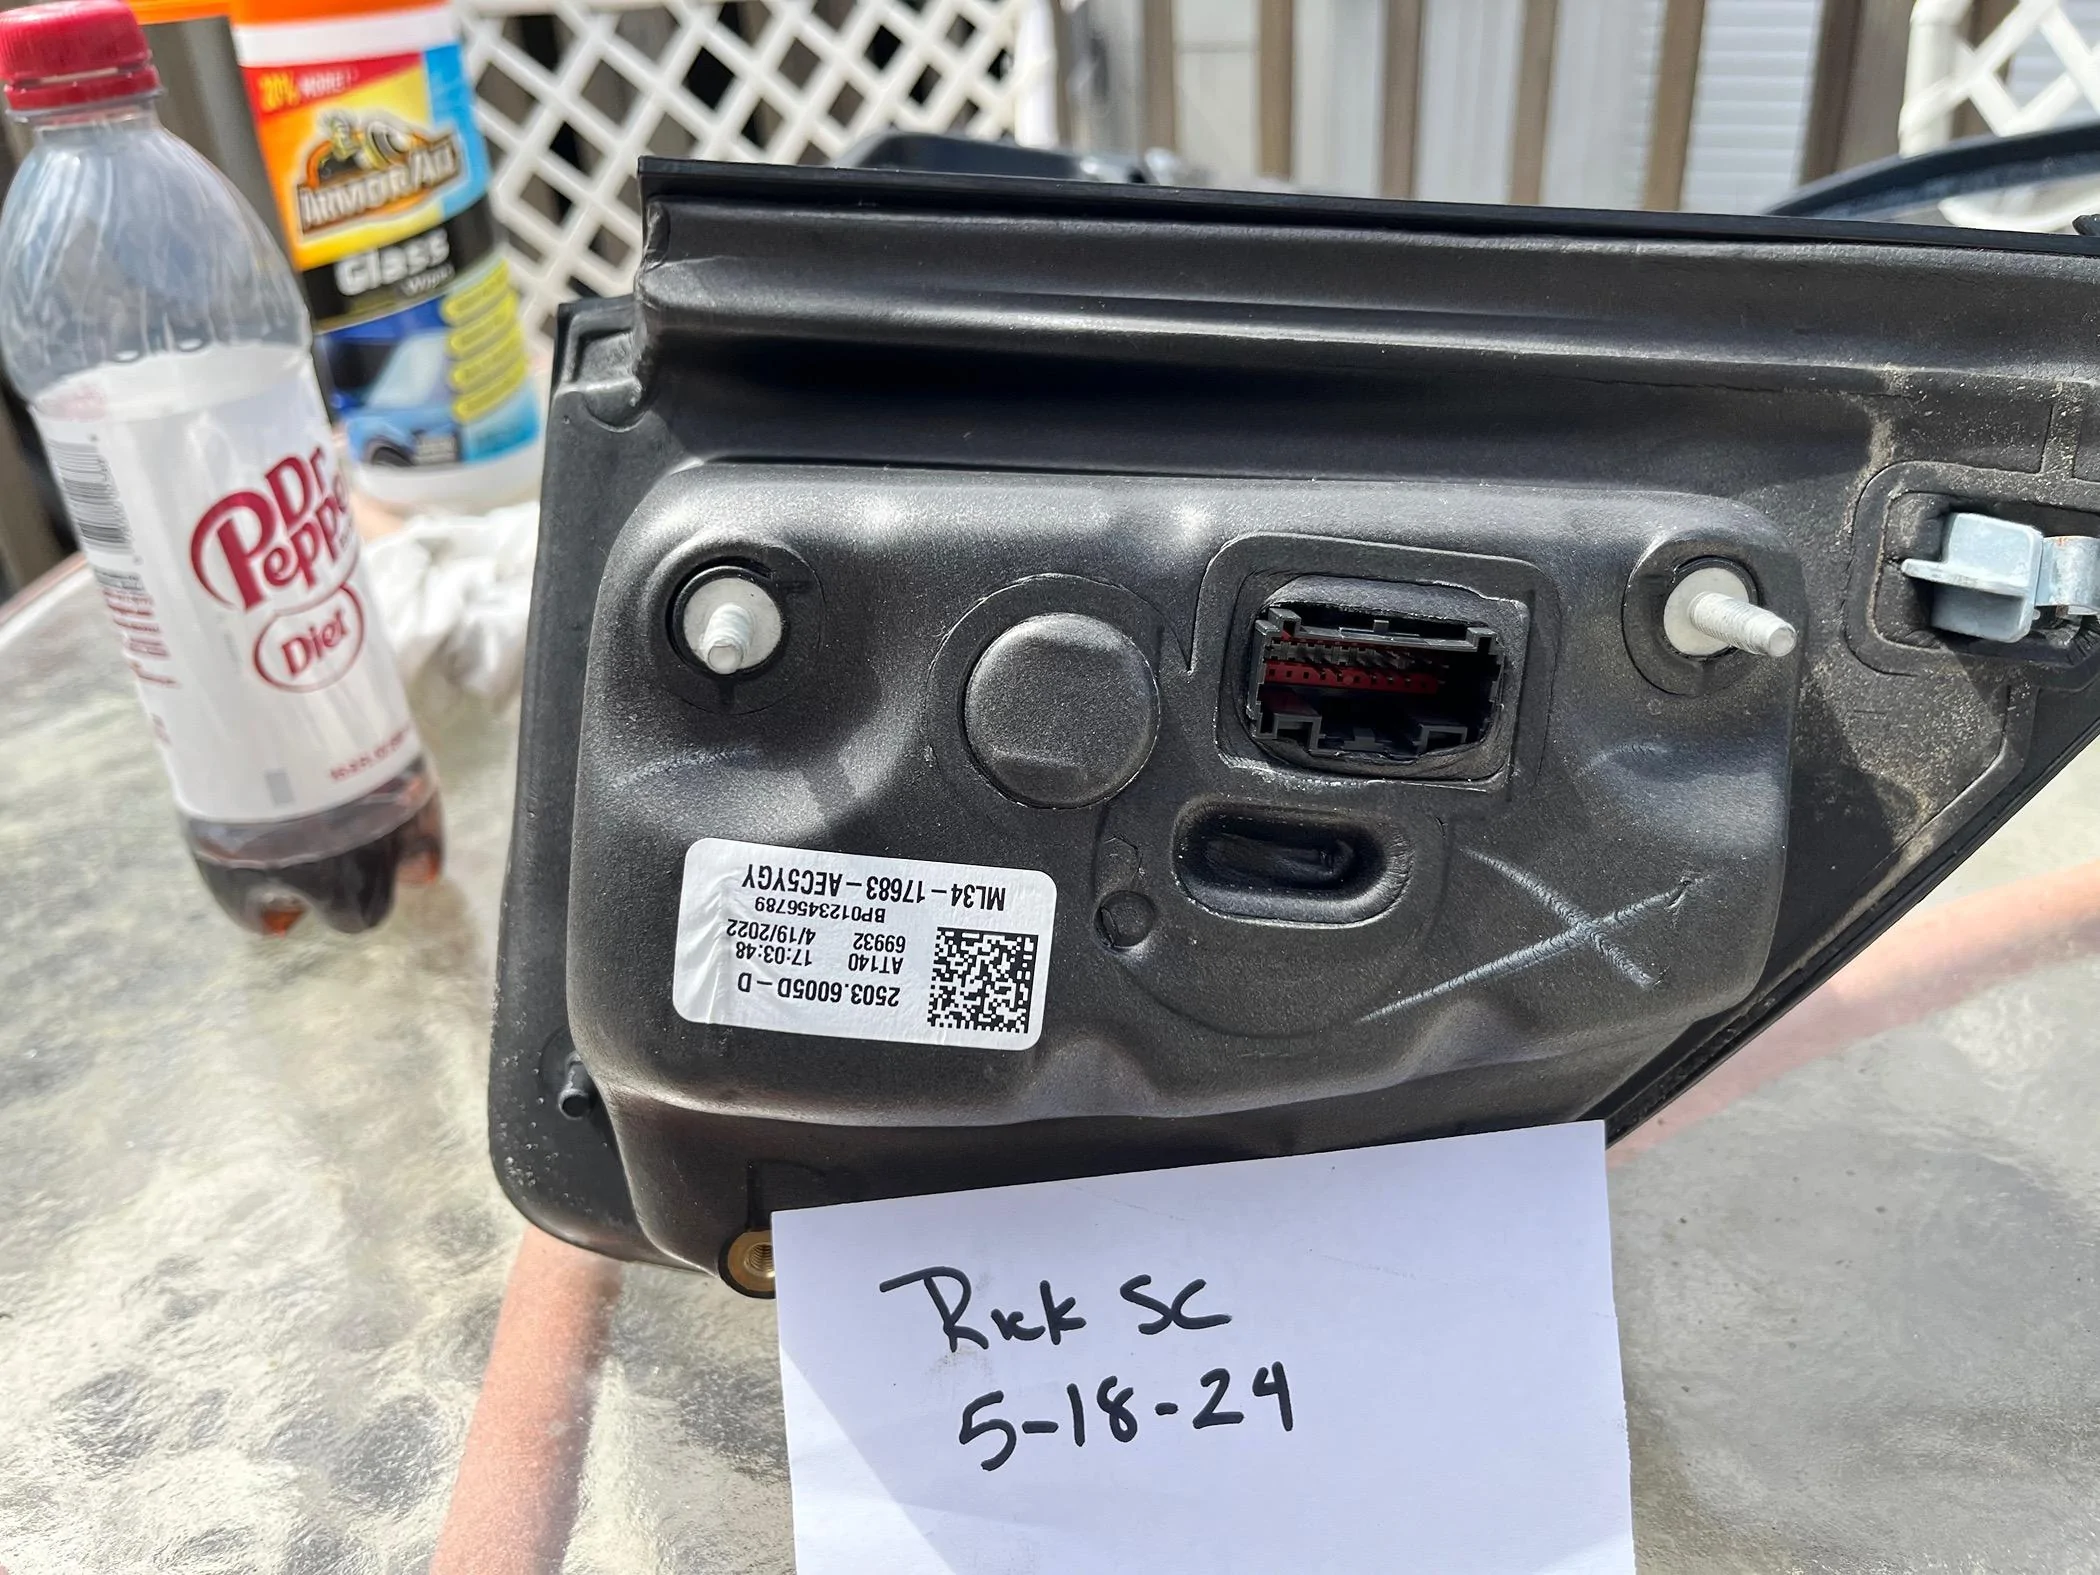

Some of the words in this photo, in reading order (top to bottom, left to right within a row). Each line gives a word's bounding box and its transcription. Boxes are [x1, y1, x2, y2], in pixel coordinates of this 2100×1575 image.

[336, 228, 450, 296] Glass
[265, 446, 327, 532] Dr
[281, 609, 348, 678] Diet
[726, 918, 816, 945] 4/19/2022
[755, 896, 886, 923] BP0123456789
[735, 941, 813, 967] 17:03:48
[847, 953, 904, 975] AT140
[853, 932, 906, 953] 69932
[880, 1266, 1087, 1353] Rick
[959, 1361, 1294, 1472] 5-18-24
